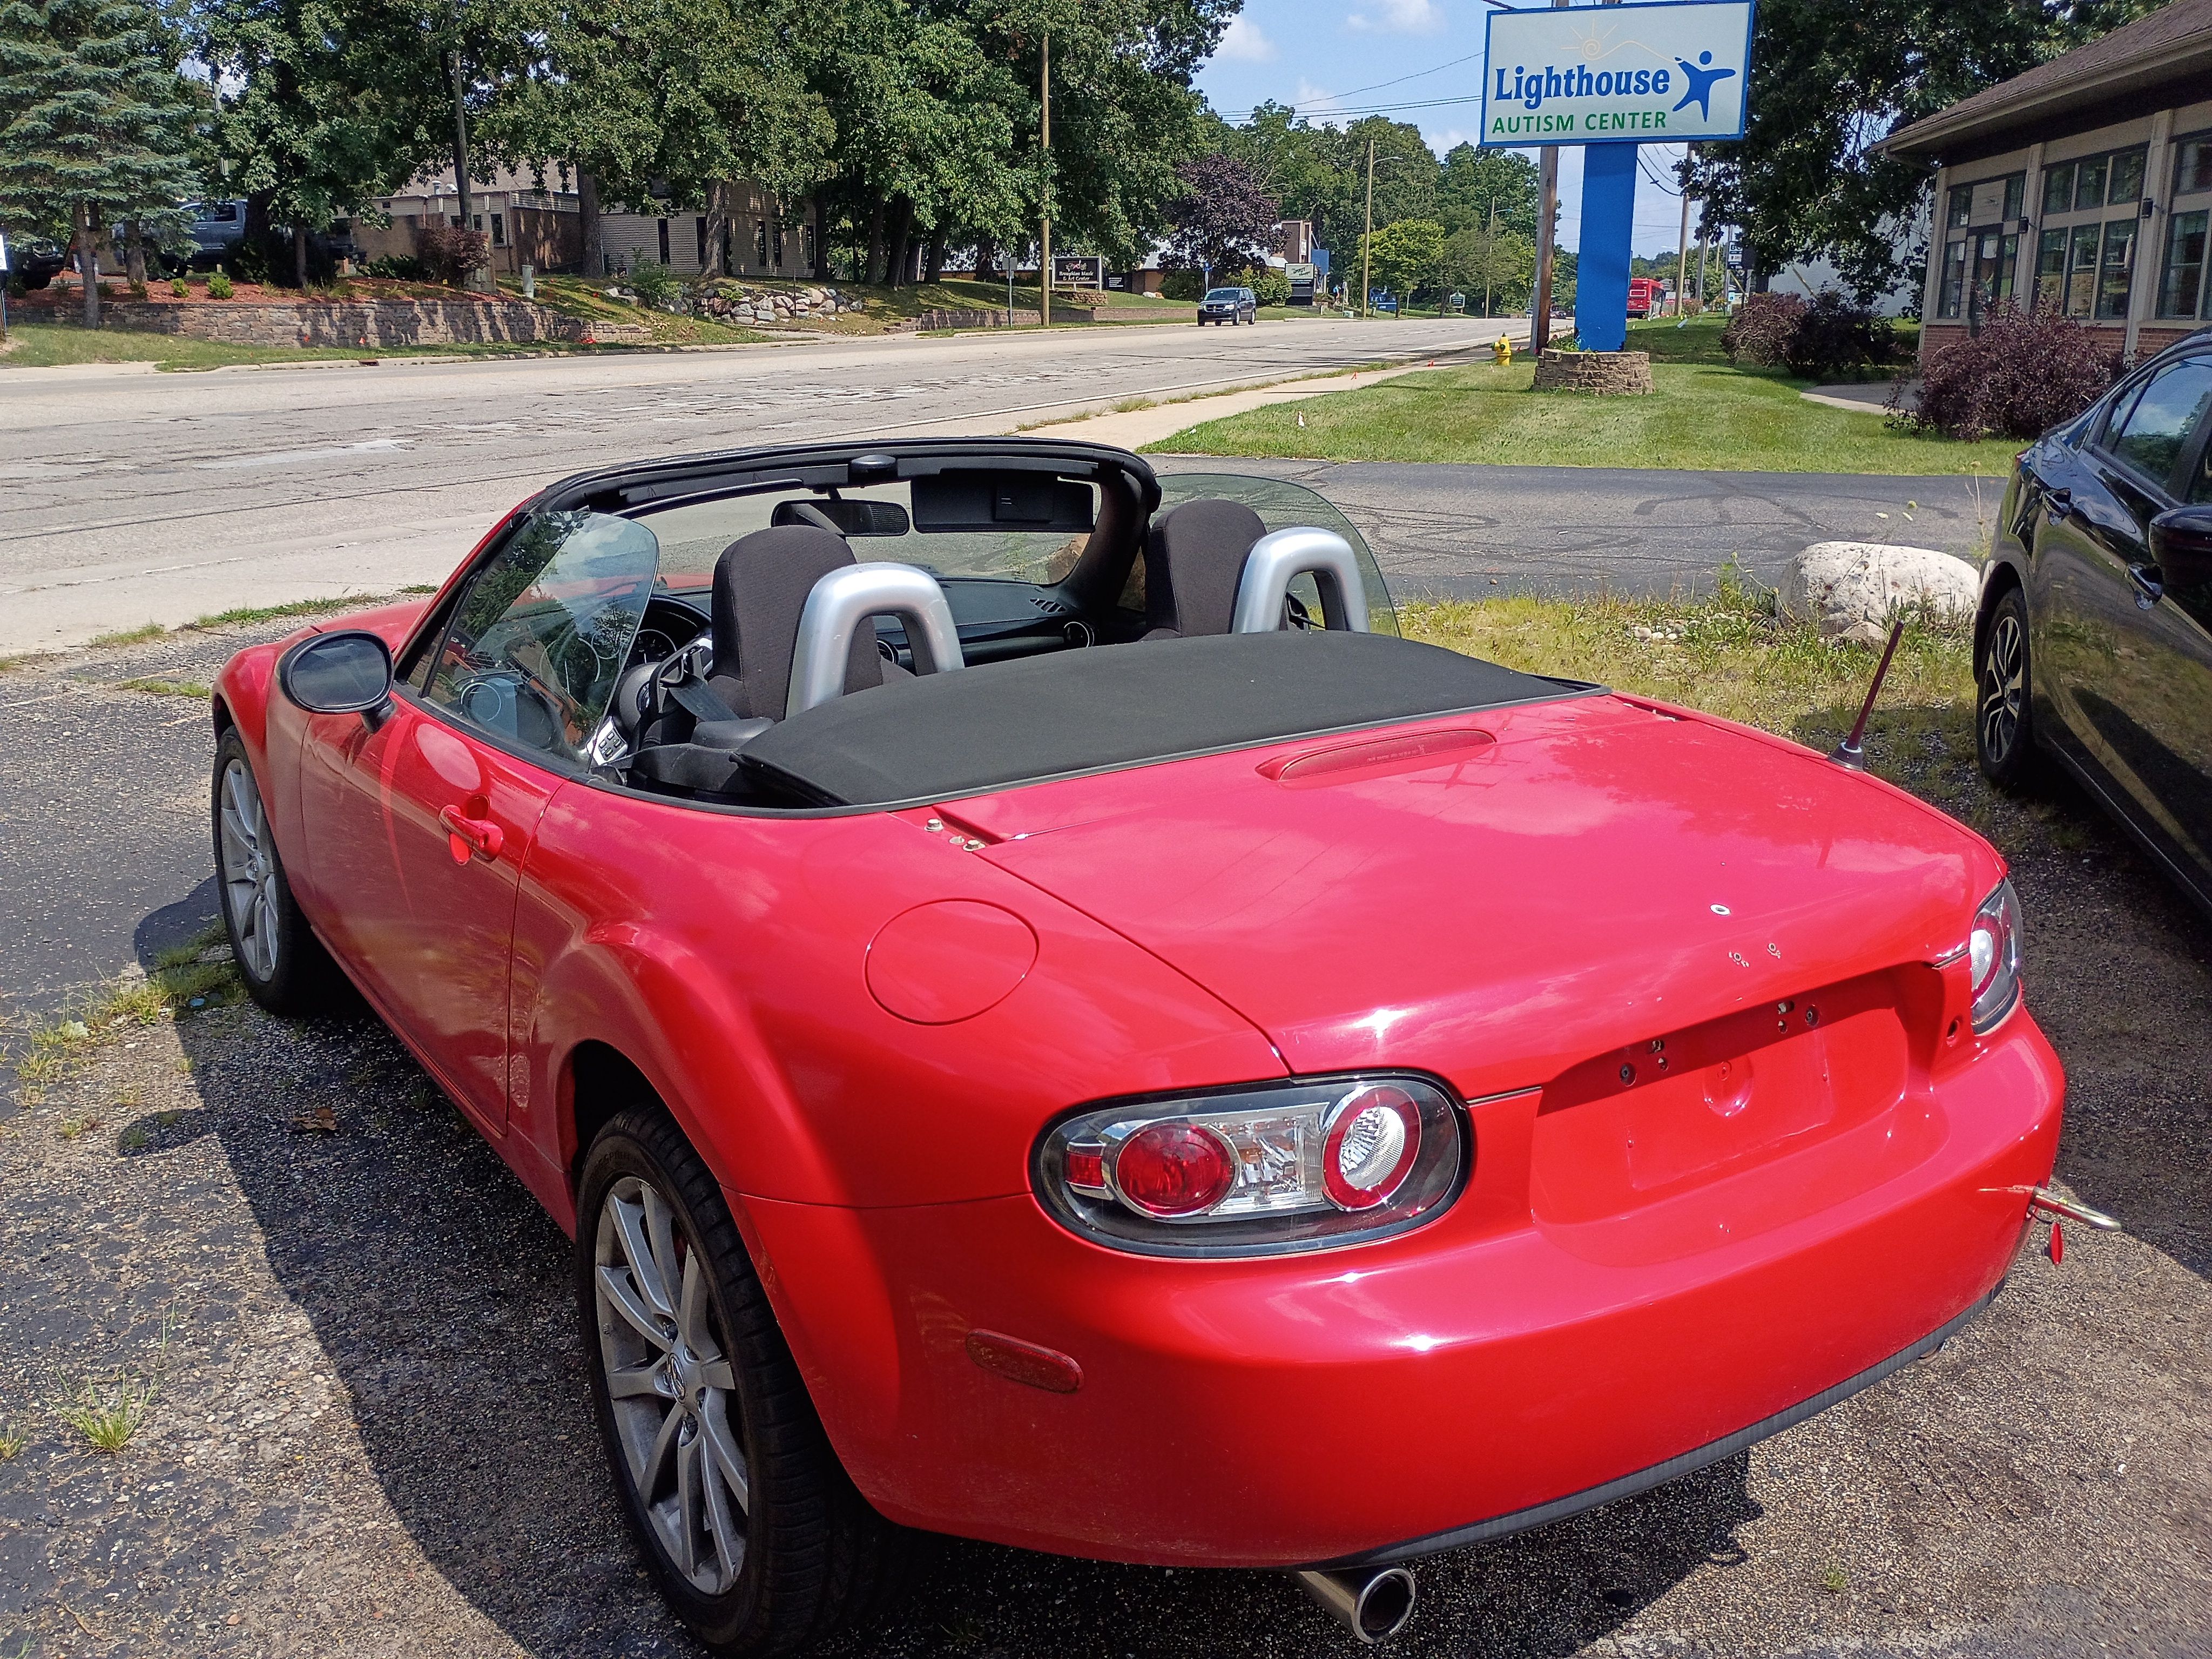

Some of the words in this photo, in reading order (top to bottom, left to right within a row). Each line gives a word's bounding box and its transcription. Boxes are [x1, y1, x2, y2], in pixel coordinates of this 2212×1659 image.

[1494, 64, 1670, 110] Lighthouse
[1492, 114, 1574, 134] AUTISM
[1584, 111, 1667, 131] CENTER
